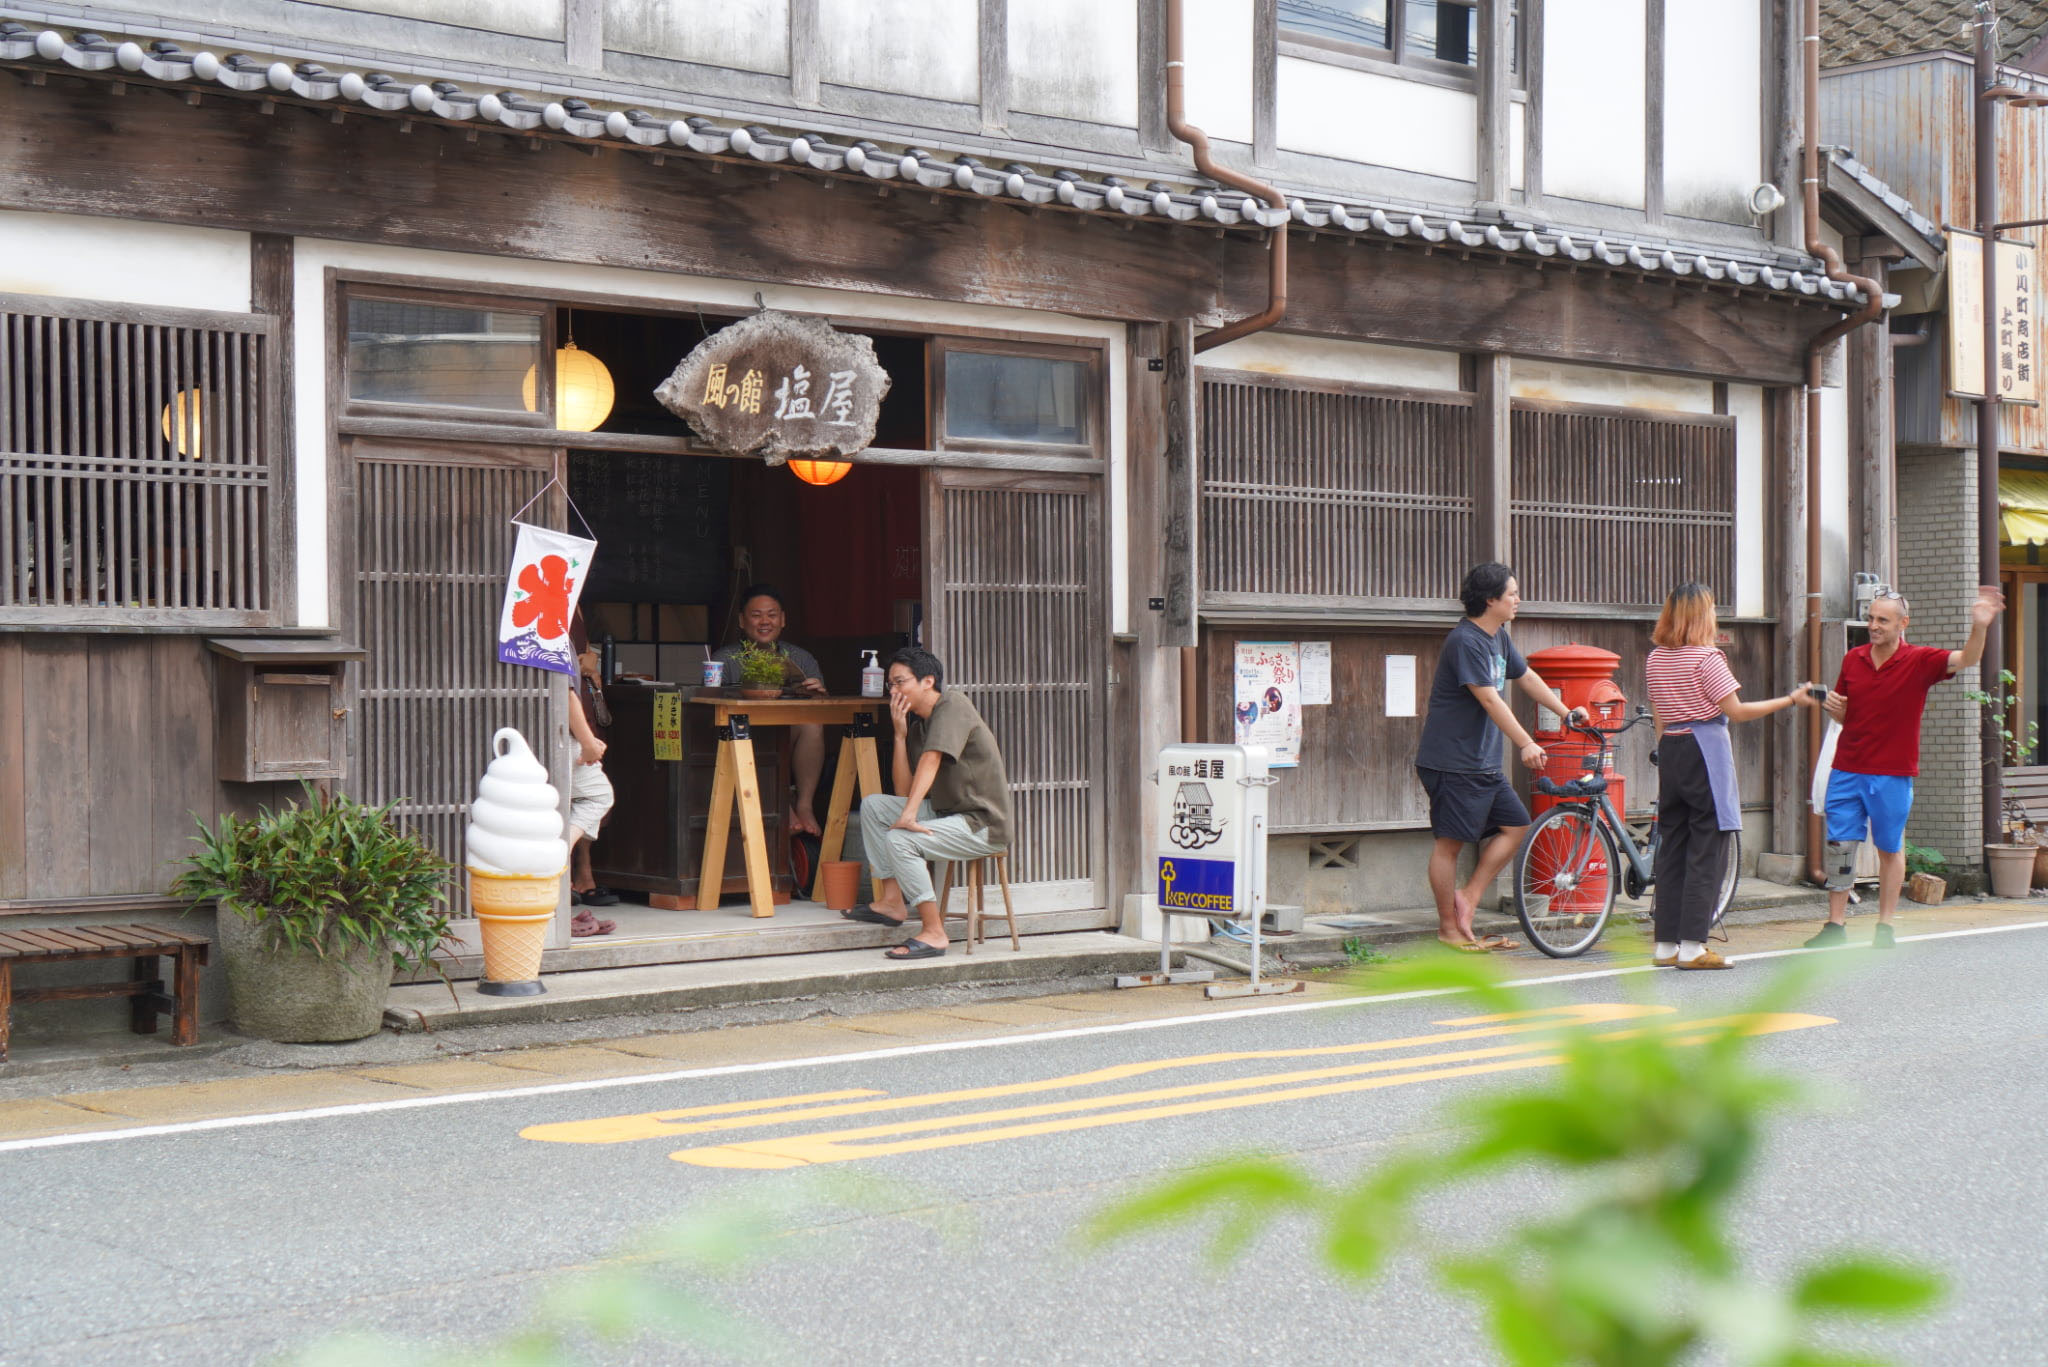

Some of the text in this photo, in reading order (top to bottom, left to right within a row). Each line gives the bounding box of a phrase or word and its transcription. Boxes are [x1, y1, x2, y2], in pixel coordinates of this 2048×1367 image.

[701, 363, 858, 427] 風の館 塩屋
[511, 554, 576, 641] 氷
[1193, 759, 1225, 780] 塩屋
[1169, 891, 1233, 911] KEY COFFEE
